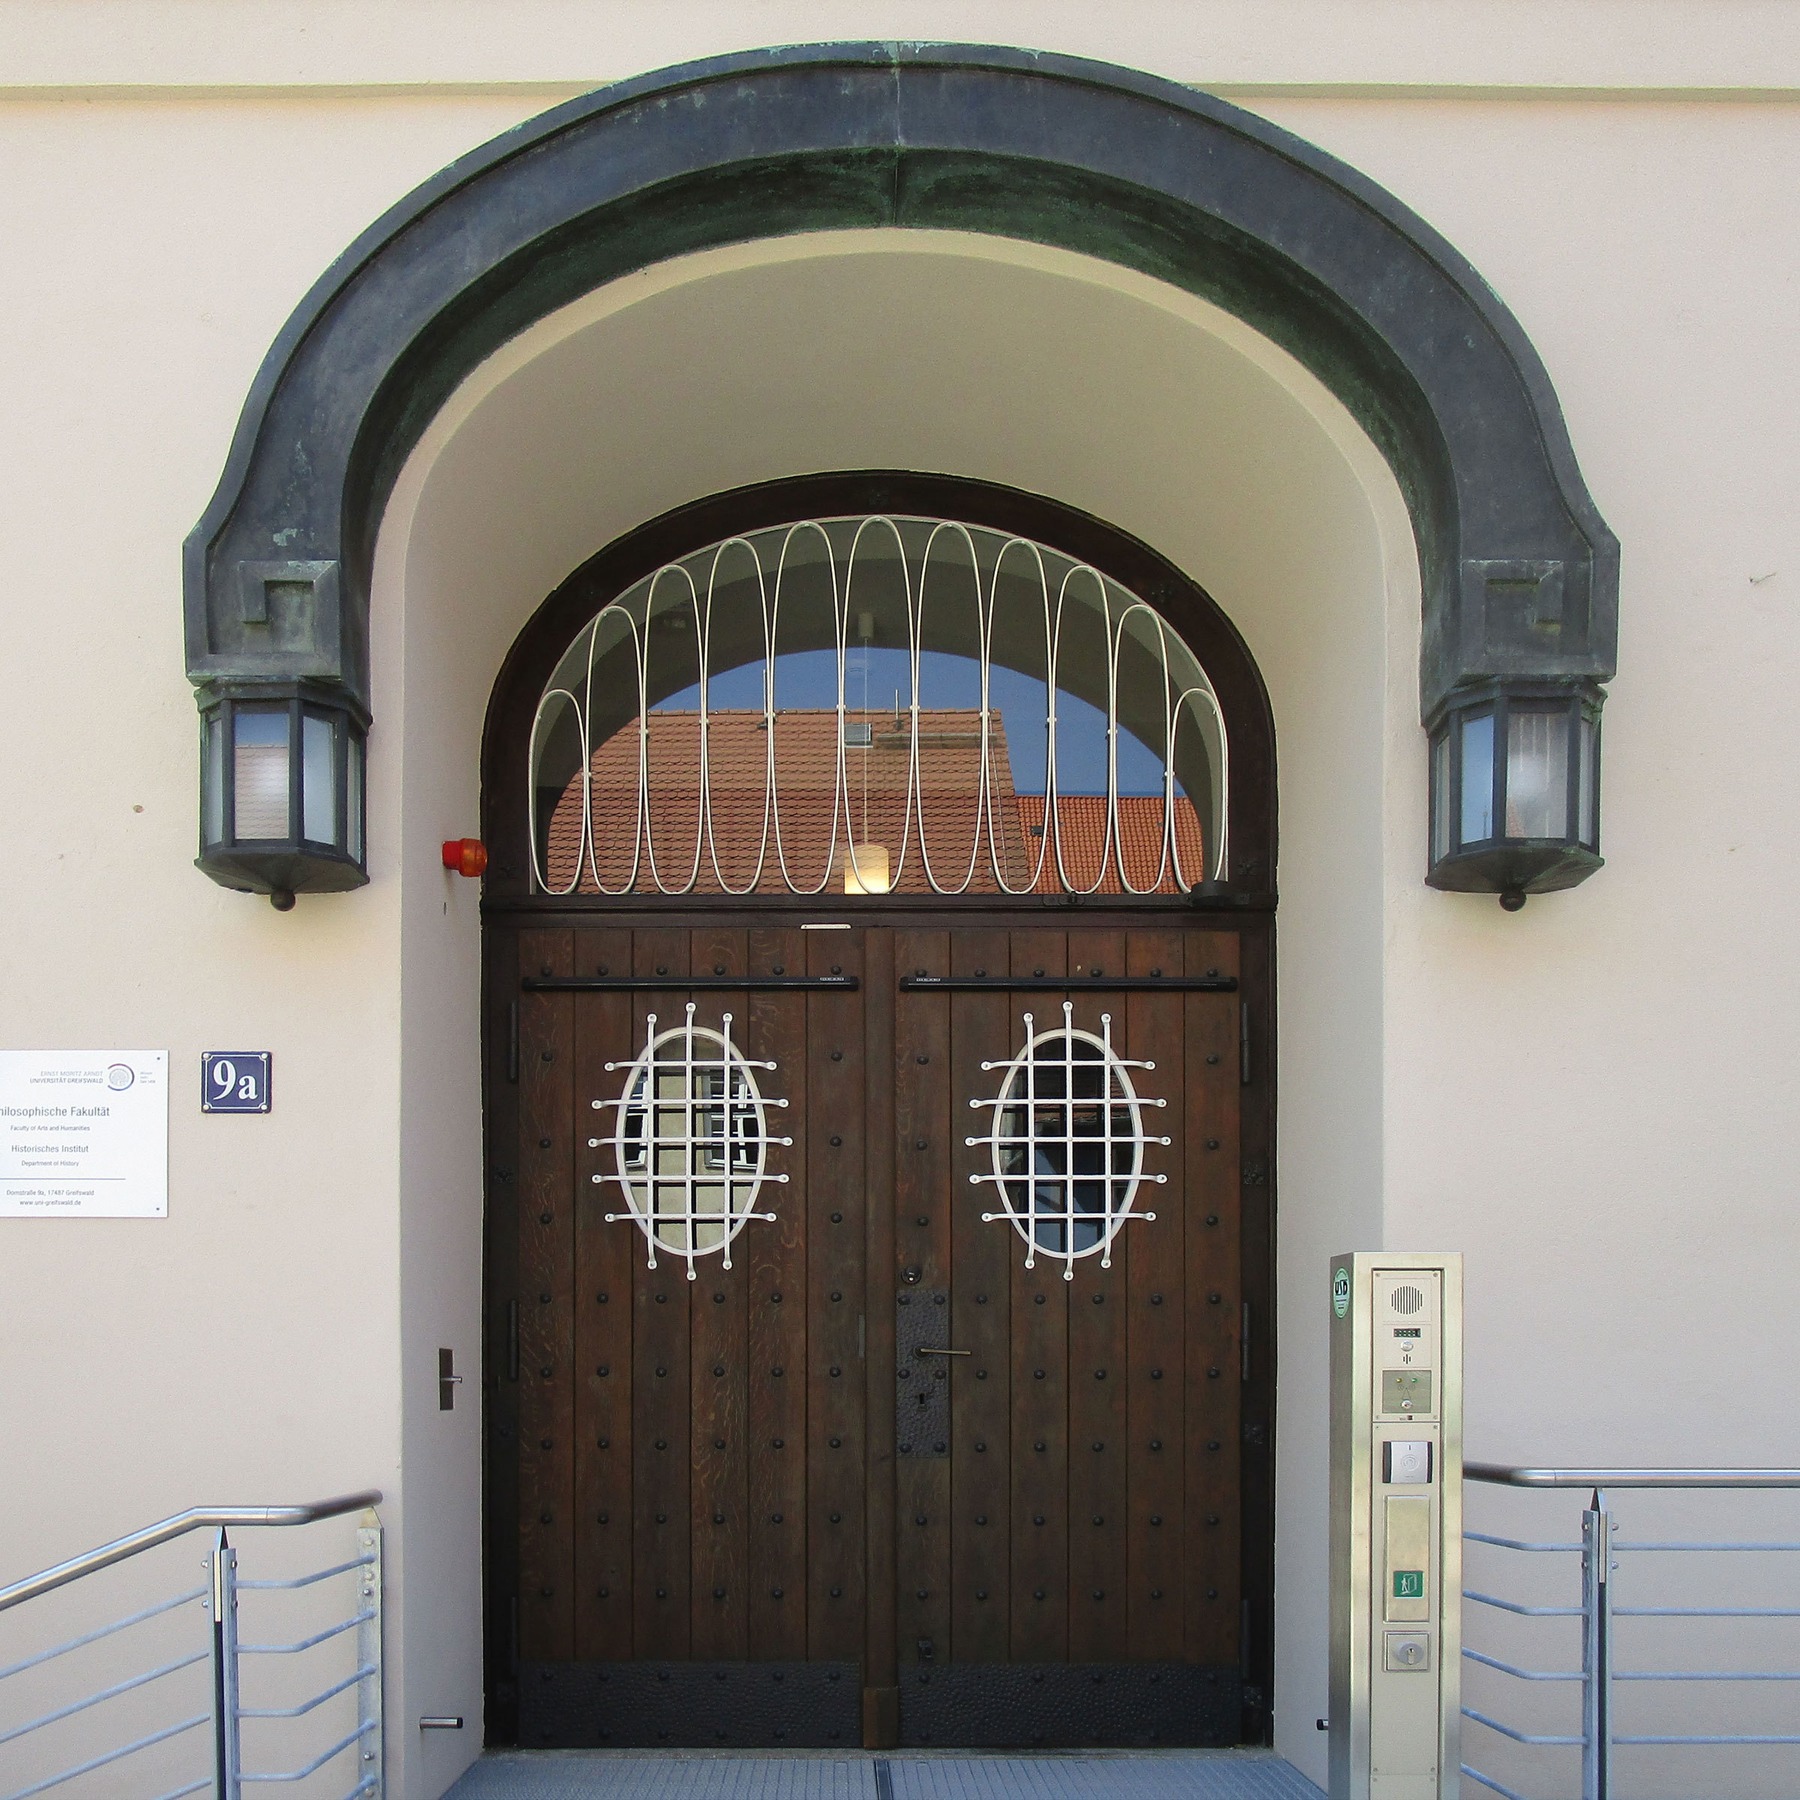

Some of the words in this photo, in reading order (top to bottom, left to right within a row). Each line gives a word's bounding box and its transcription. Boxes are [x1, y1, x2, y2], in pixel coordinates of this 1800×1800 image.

[213, 1060, 258, 1100] 9a
[70, 1106, 110, 1116] Fakultät
[11, 1145, 59, 1153] Historisches
[61, 1145, 89, 1153] Institut
